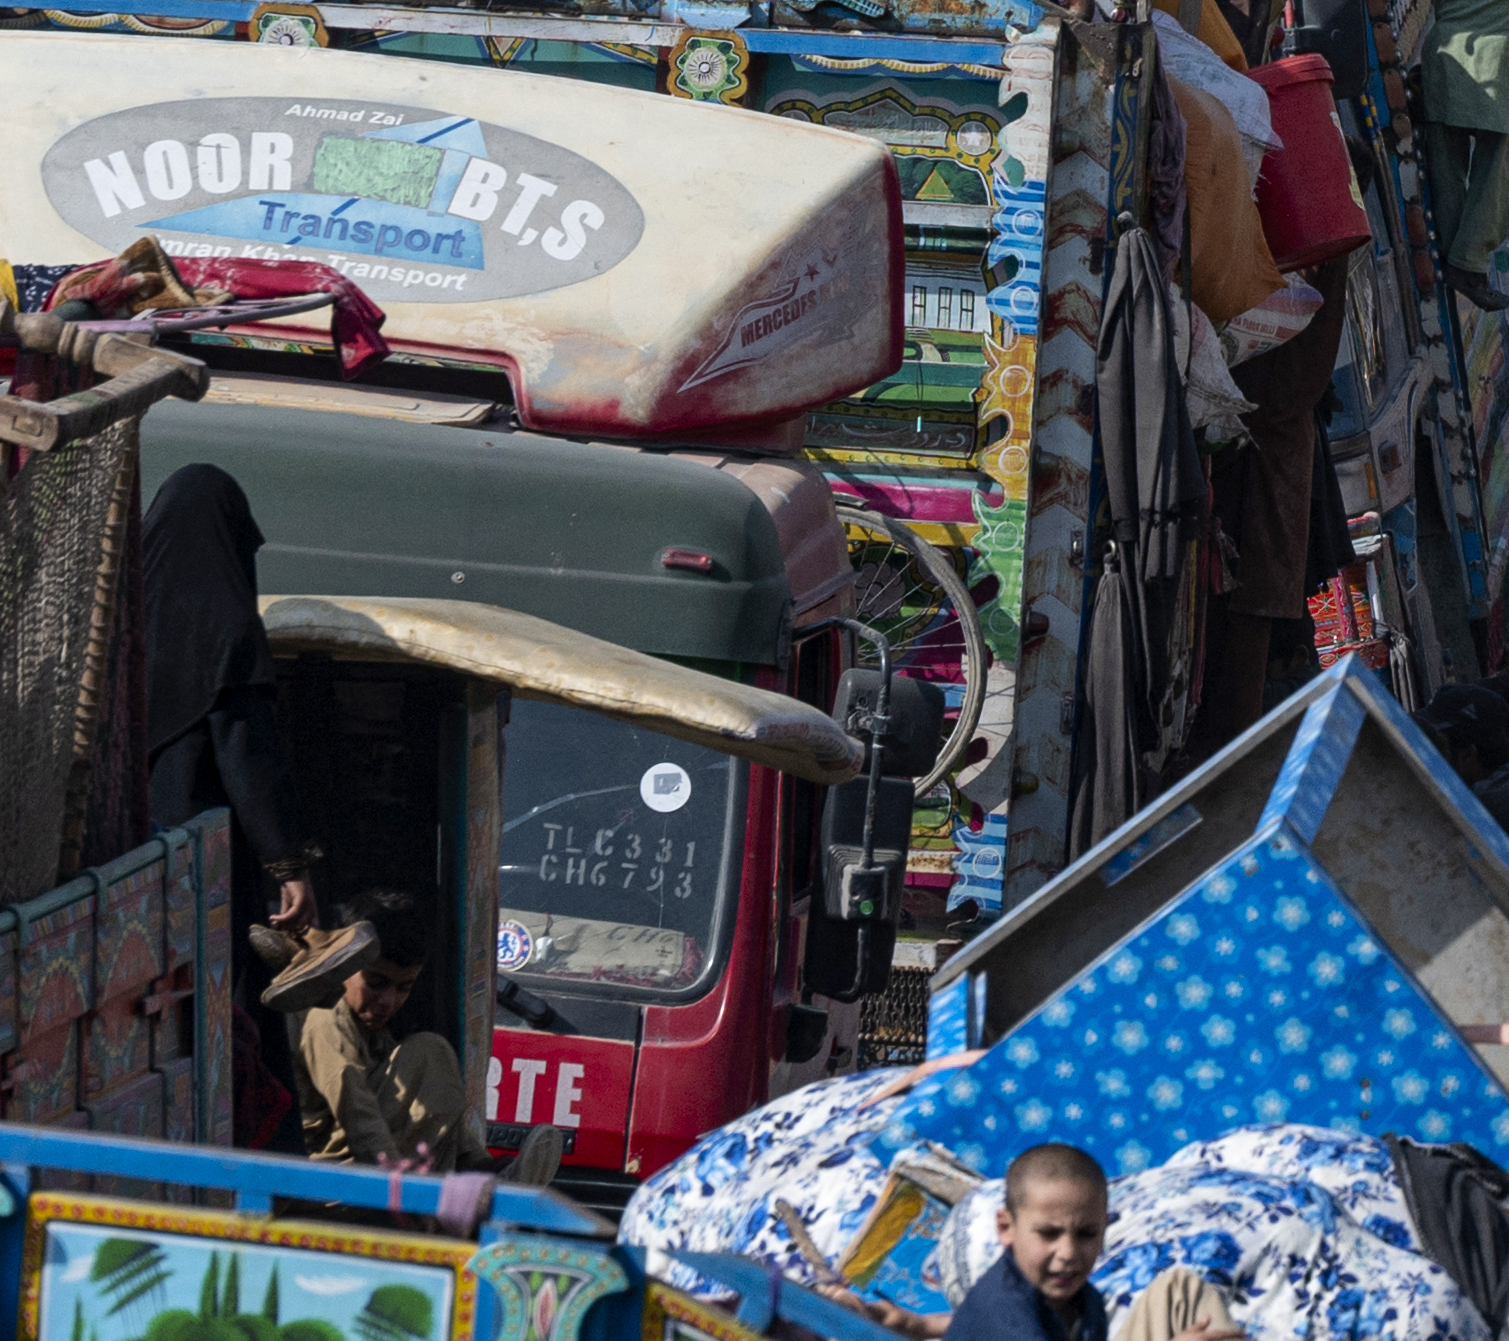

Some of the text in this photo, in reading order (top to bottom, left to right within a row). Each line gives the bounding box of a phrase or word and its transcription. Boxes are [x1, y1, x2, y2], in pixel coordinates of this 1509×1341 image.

[285, 103, 405, 128] Ahmad Zai
[83, 131, 295, 218] NOOR
[258, 200, 467, 260] Transport
[326, 254, 469, 294] Transport
